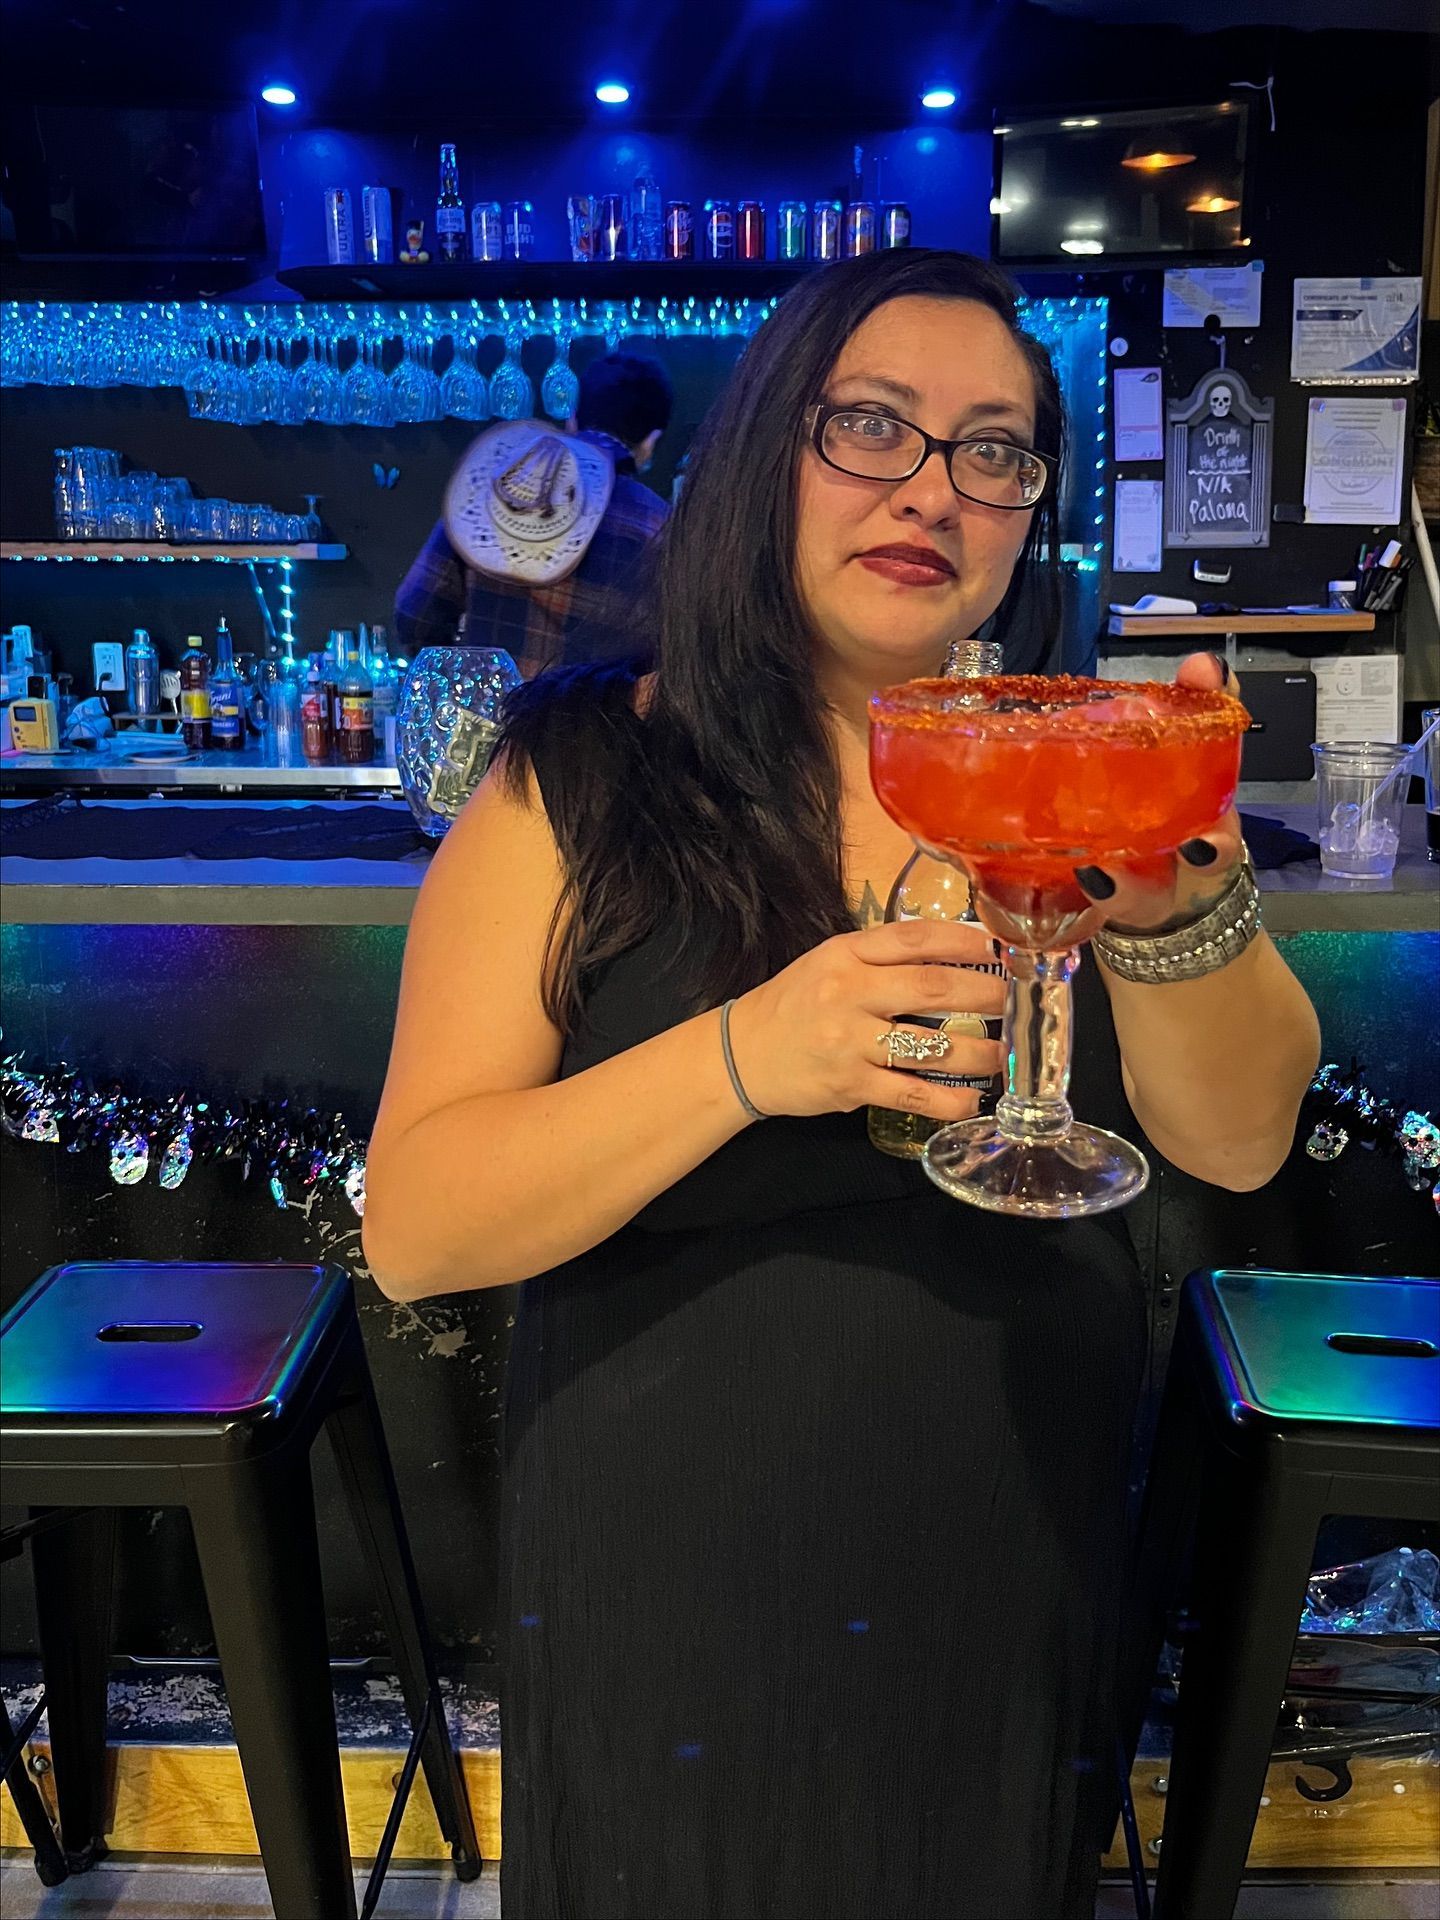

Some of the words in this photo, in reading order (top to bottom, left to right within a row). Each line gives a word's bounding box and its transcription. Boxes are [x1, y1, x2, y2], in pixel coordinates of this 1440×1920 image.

[338, 209, 348, 251] ULTRA
[1199, 454, 1218, 469] the
[1197, 476, 1232, 495] N/A
[1189, 499, 1250, 525] Paloma
